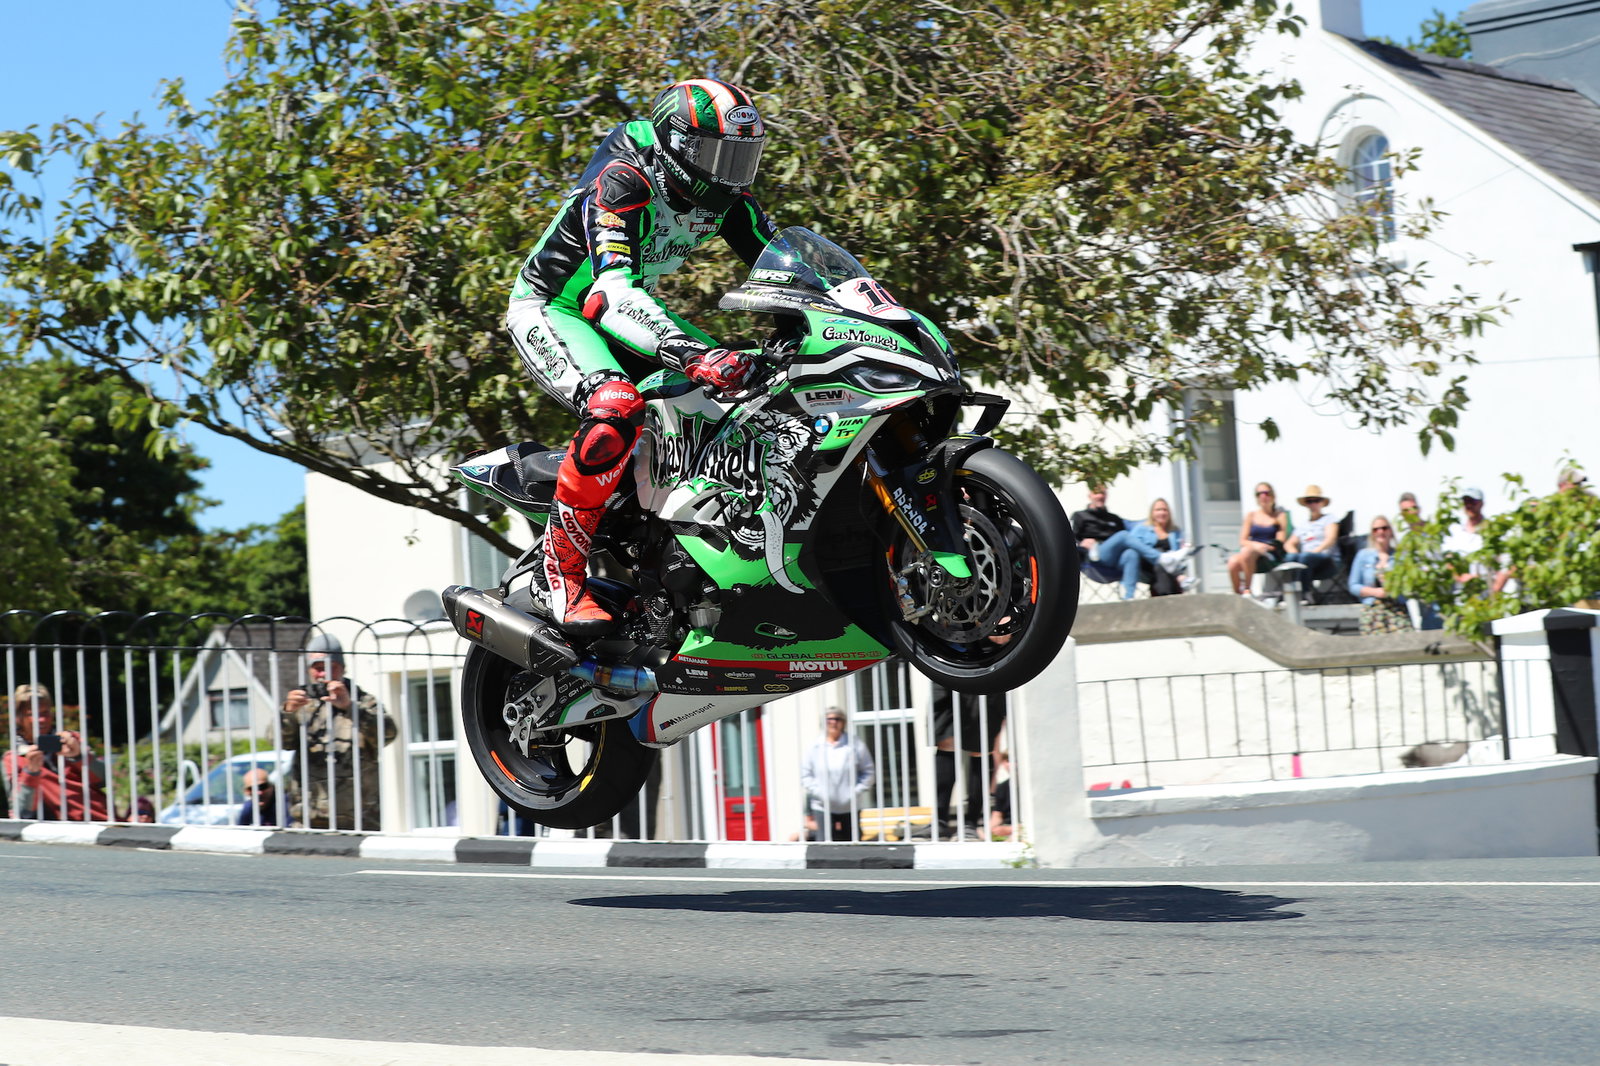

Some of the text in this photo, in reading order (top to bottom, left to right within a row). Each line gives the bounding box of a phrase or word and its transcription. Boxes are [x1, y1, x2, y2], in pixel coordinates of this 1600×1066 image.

[662, 151, 692, 185] MONSTER
[655, 170, 671, 203] Weise
[822, 326, 899, 351] GasMonkey
[600, 389, 635, 401] Weise
[804, 390, 843, 401] LEW
[836, 428, 855, 437] TT
[918, 469, 936, 481] sbs
[892, 486, 928, 535] DUNLOP
[685, 668, 709, 676] LEW
[789, 661, 848, 671] MOTUL
[675, 702, 716, 722] Motorsport
